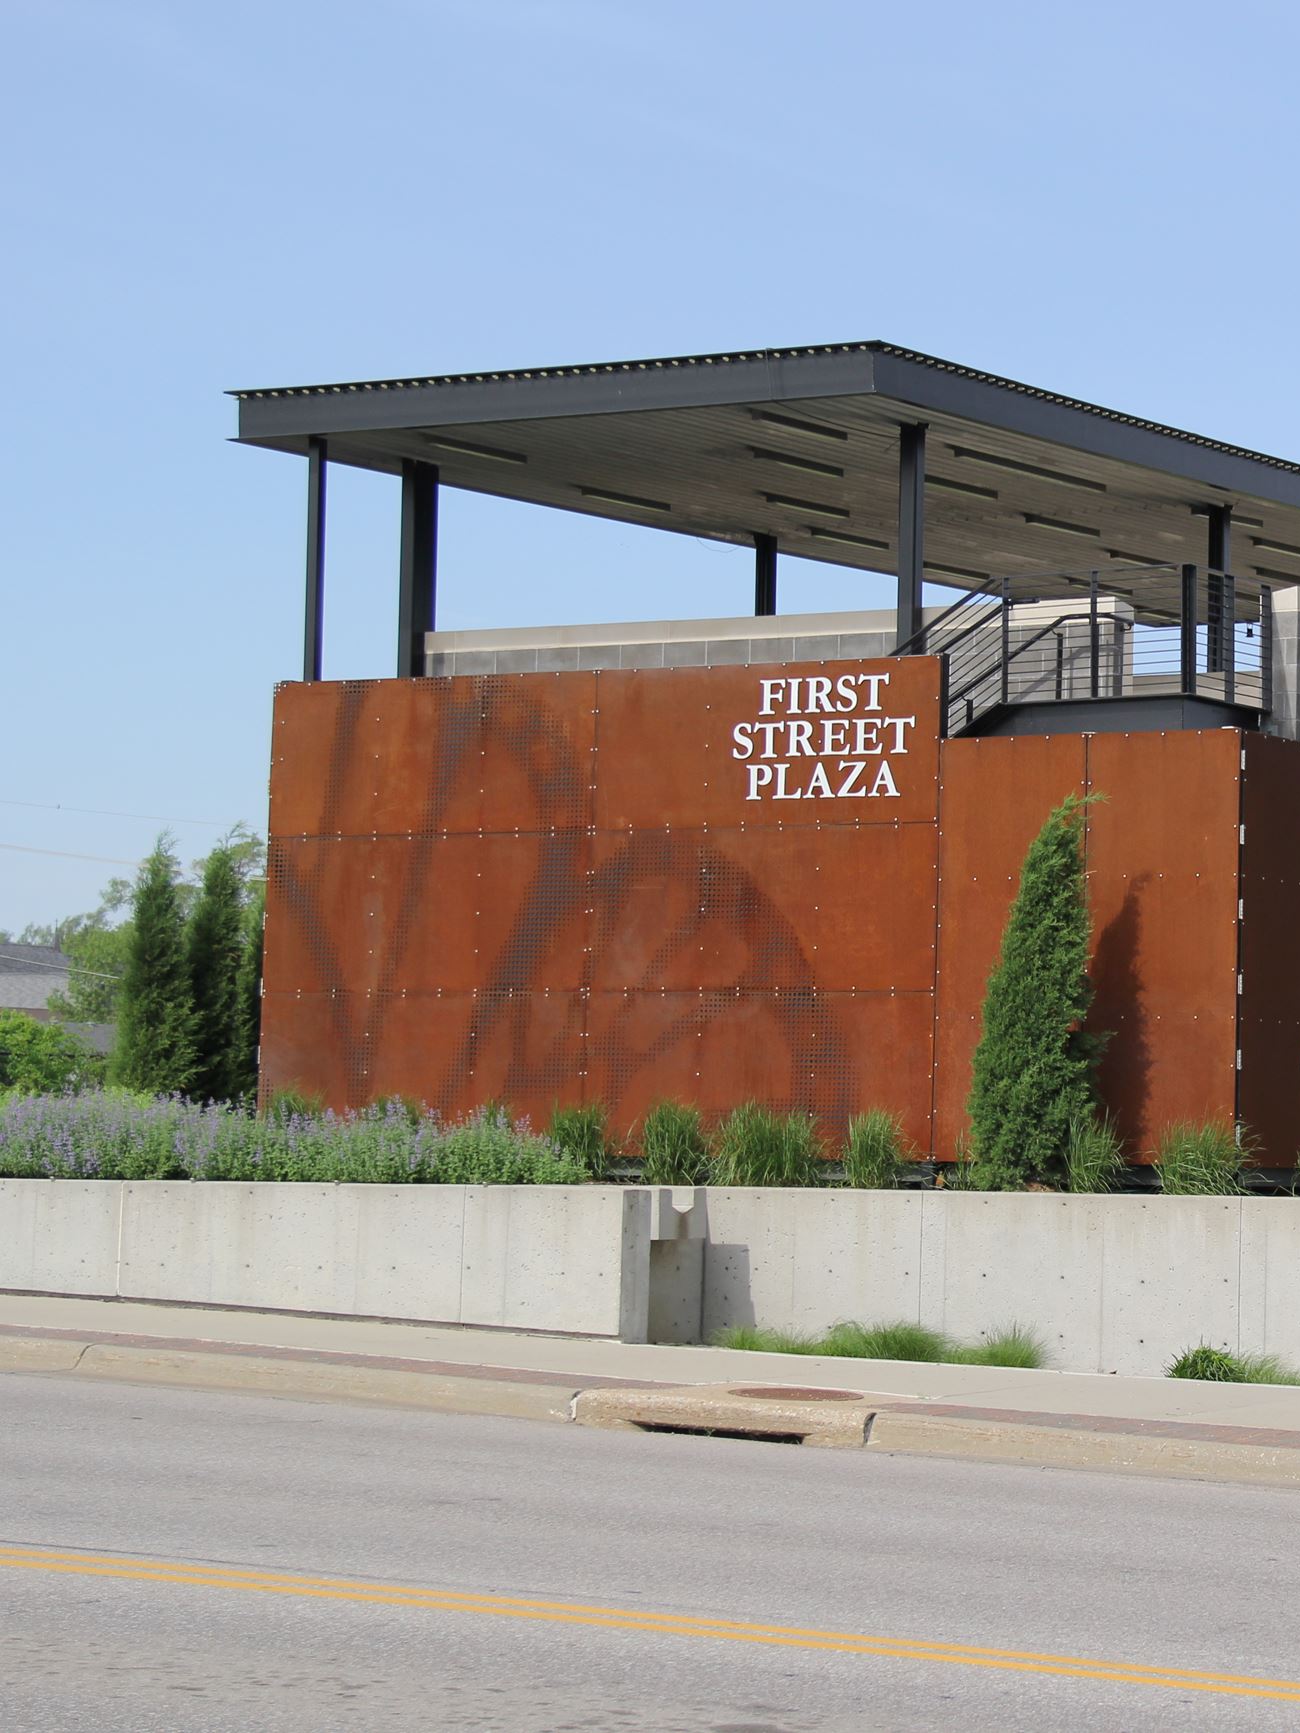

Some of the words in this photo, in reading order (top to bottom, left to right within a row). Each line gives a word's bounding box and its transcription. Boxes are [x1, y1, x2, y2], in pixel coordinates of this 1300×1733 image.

[758, 672, 890, 716] FIRST
[732, 715, 916, 760] STREET
[746, 760, 901, 801] PLAZA
